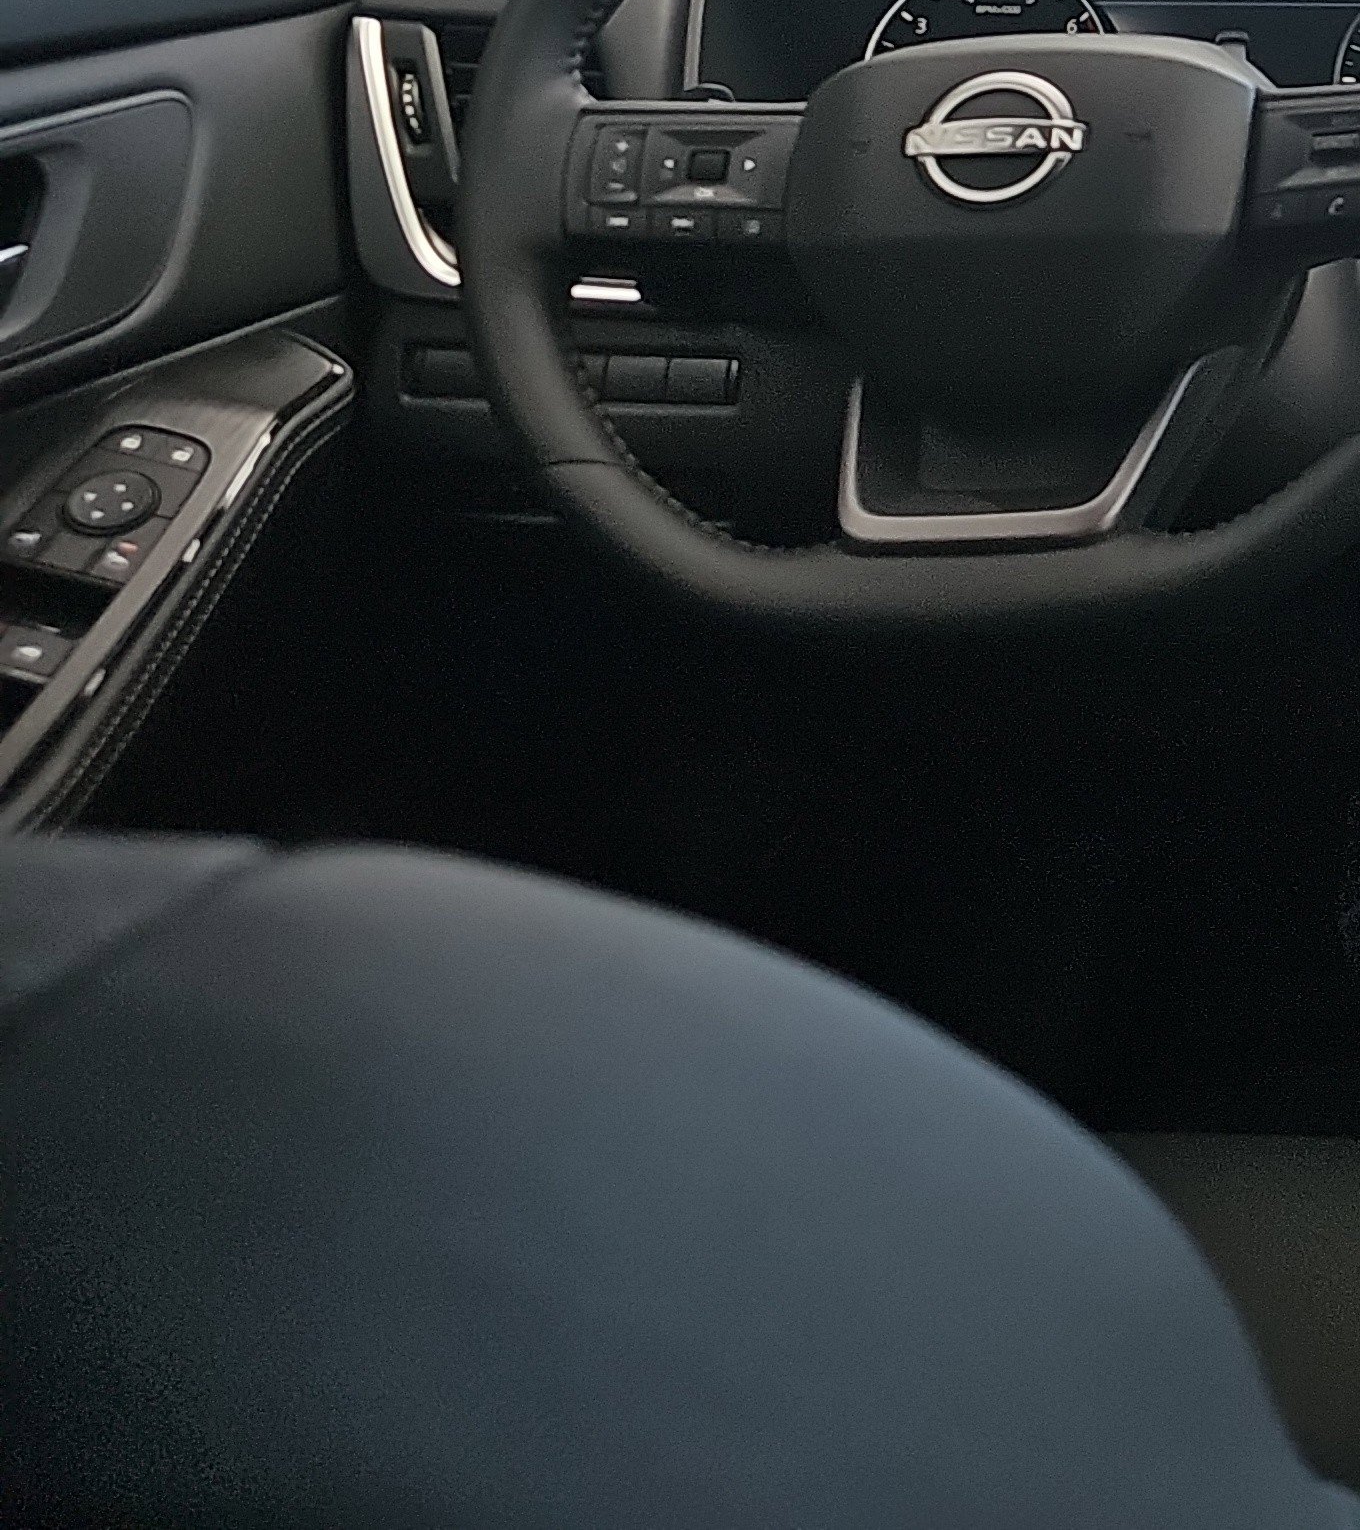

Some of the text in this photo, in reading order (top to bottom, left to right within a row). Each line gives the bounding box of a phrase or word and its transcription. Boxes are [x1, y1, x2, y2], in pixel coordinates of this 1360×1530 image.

[915, 17, 927, 35] 3
[1066, 18, 1078, 35] 6
[905, 127, 1083, 157] NISSAN
